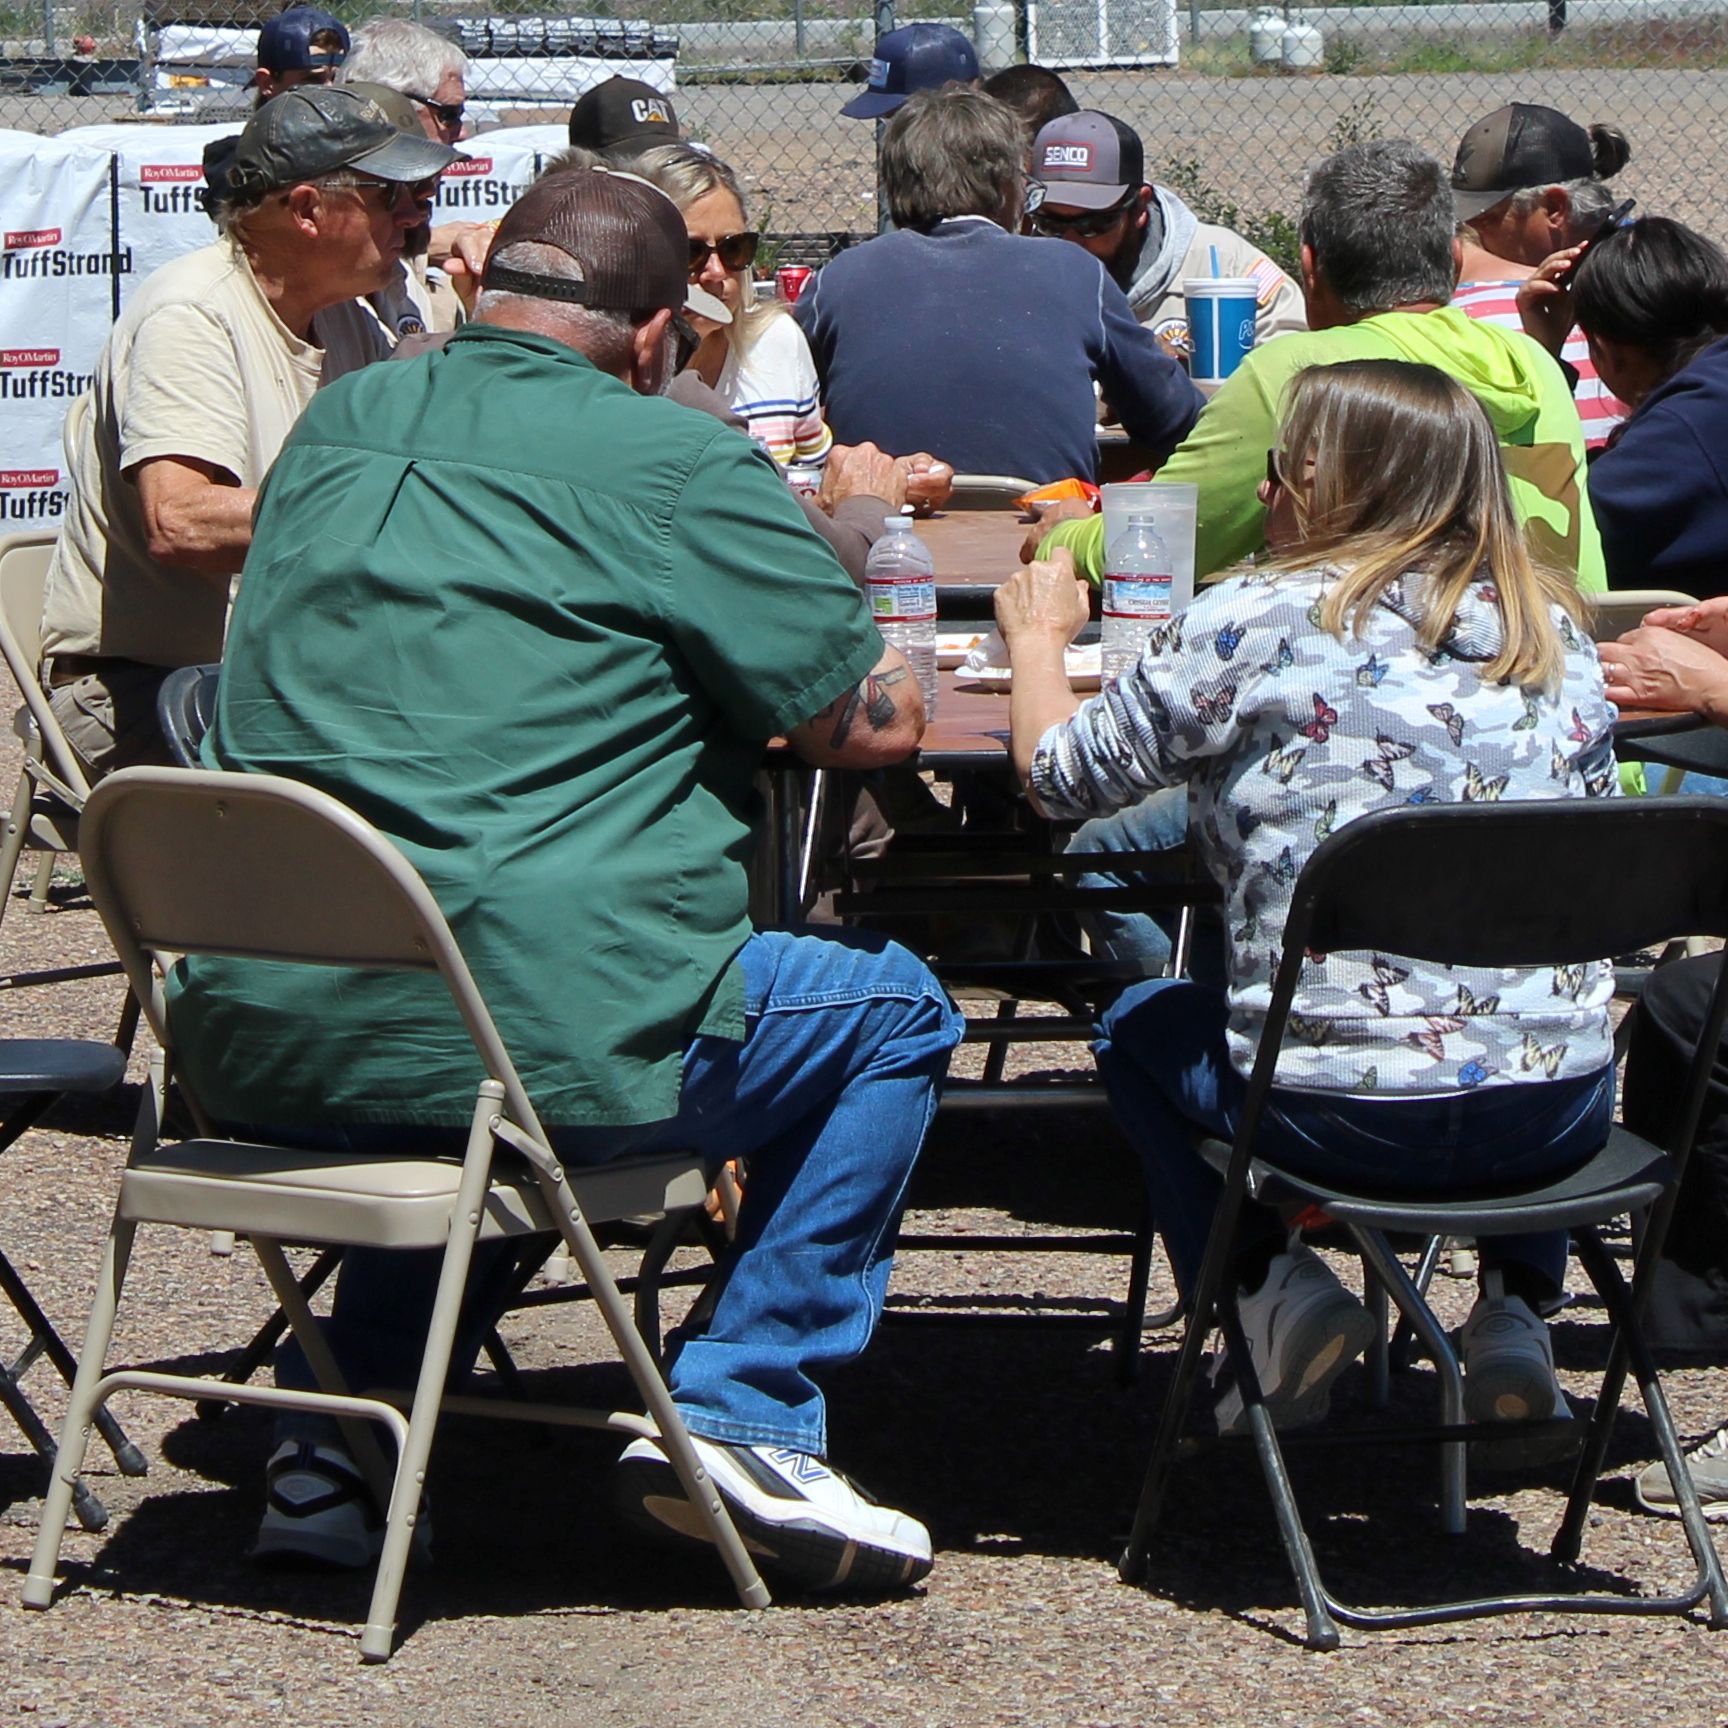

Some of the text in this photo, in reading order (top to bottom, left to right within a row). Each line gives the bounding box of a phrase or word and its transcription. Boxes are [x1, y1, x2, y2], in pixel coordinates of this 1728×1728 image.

[632, 98, 670, 123] CAT
[1045, 146, 1088, 162] SENCO
[144, 167, 198, 180] RoyOMartin
[435, 180, 528, 207] TuffStr
[3, 352, 57, 366] RoyOMartin
[1, 473, 55, 486] RoyOMartin
